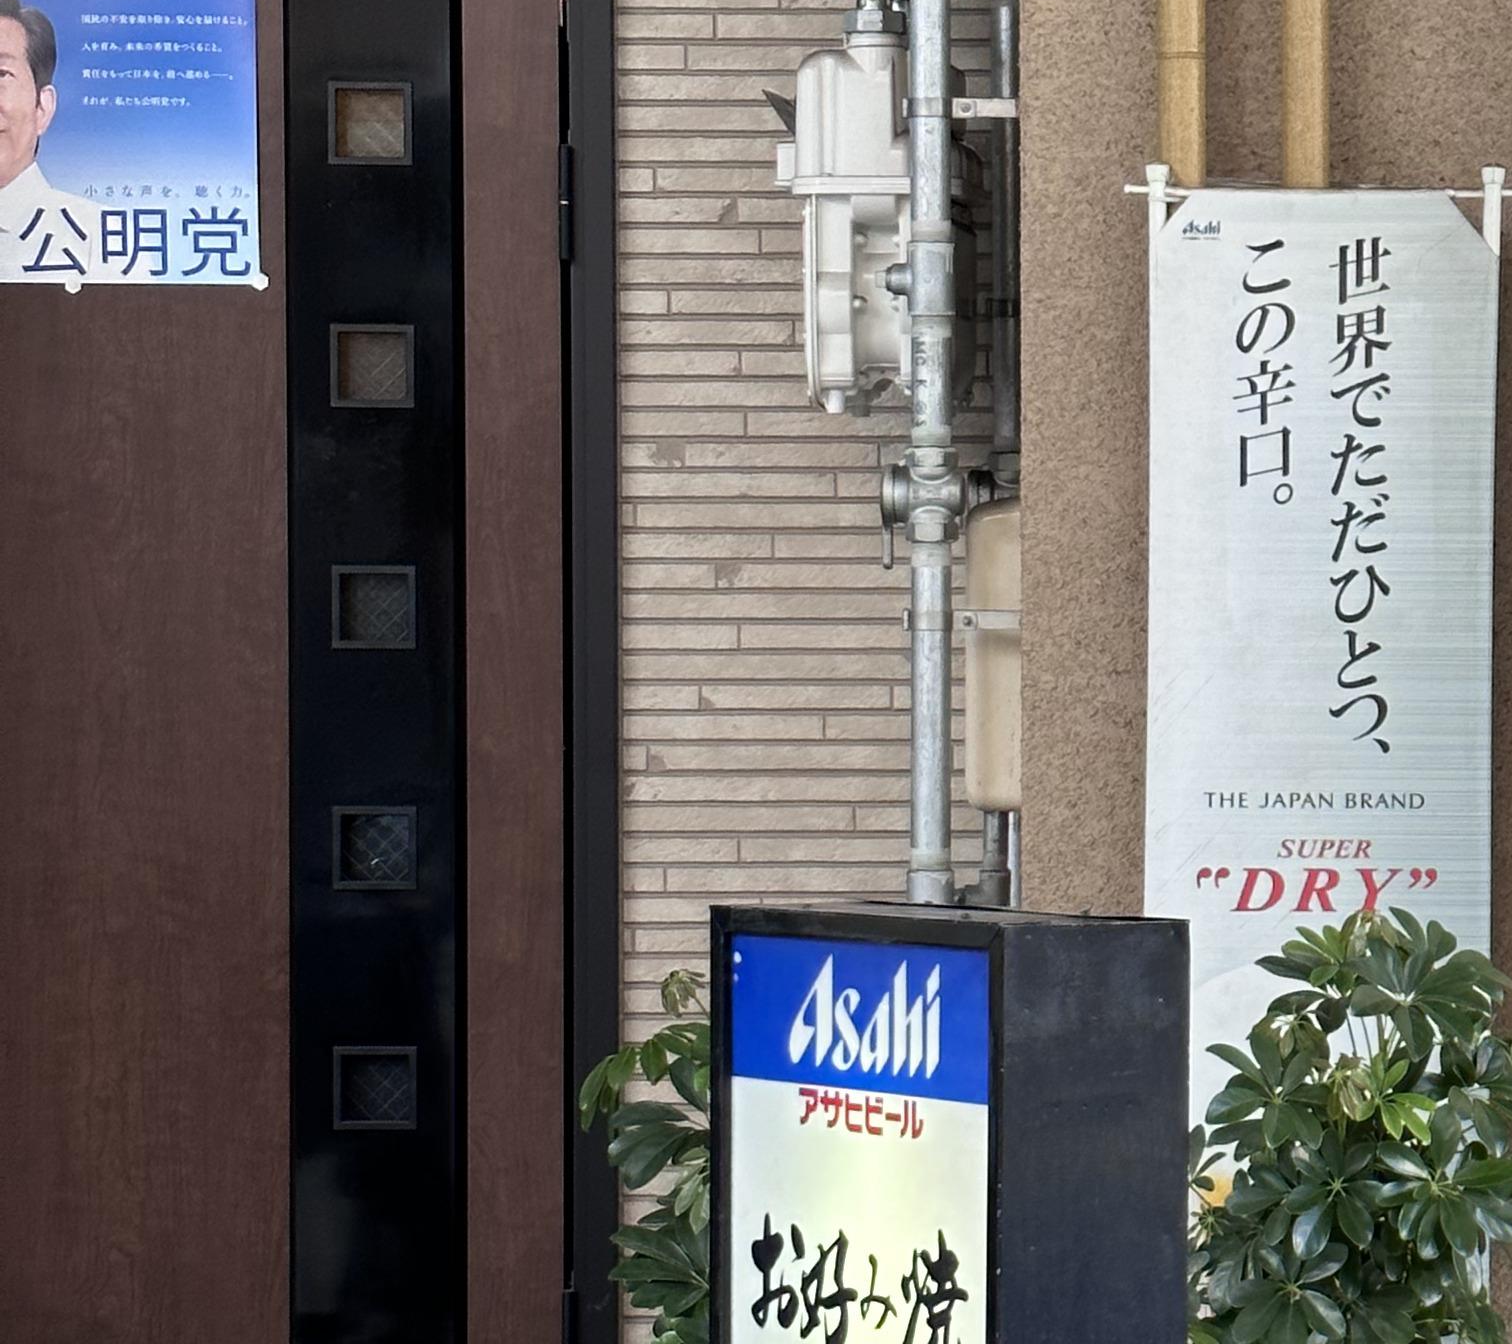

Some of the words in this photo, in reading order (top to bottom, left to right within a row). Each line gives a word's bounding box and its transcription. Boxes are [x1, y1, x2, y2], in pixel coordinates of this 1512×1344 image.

[19, 206, 251, 277] 公明党
[1234, 238, 1297, 506] この辛口。
[1328, 236, 1392, 754] 世界でただひとつ、
[1204, 792, 1248, 808] THE
[1258, 792, 1334, 809] JAPAN
[1345, 793, 1425, 809] BRAND
[1277, 838, 1373, 859] SUPER
[788, 953, 941, 1080] Asahi
[799, 1087, 924, 1140] アサヒビール
